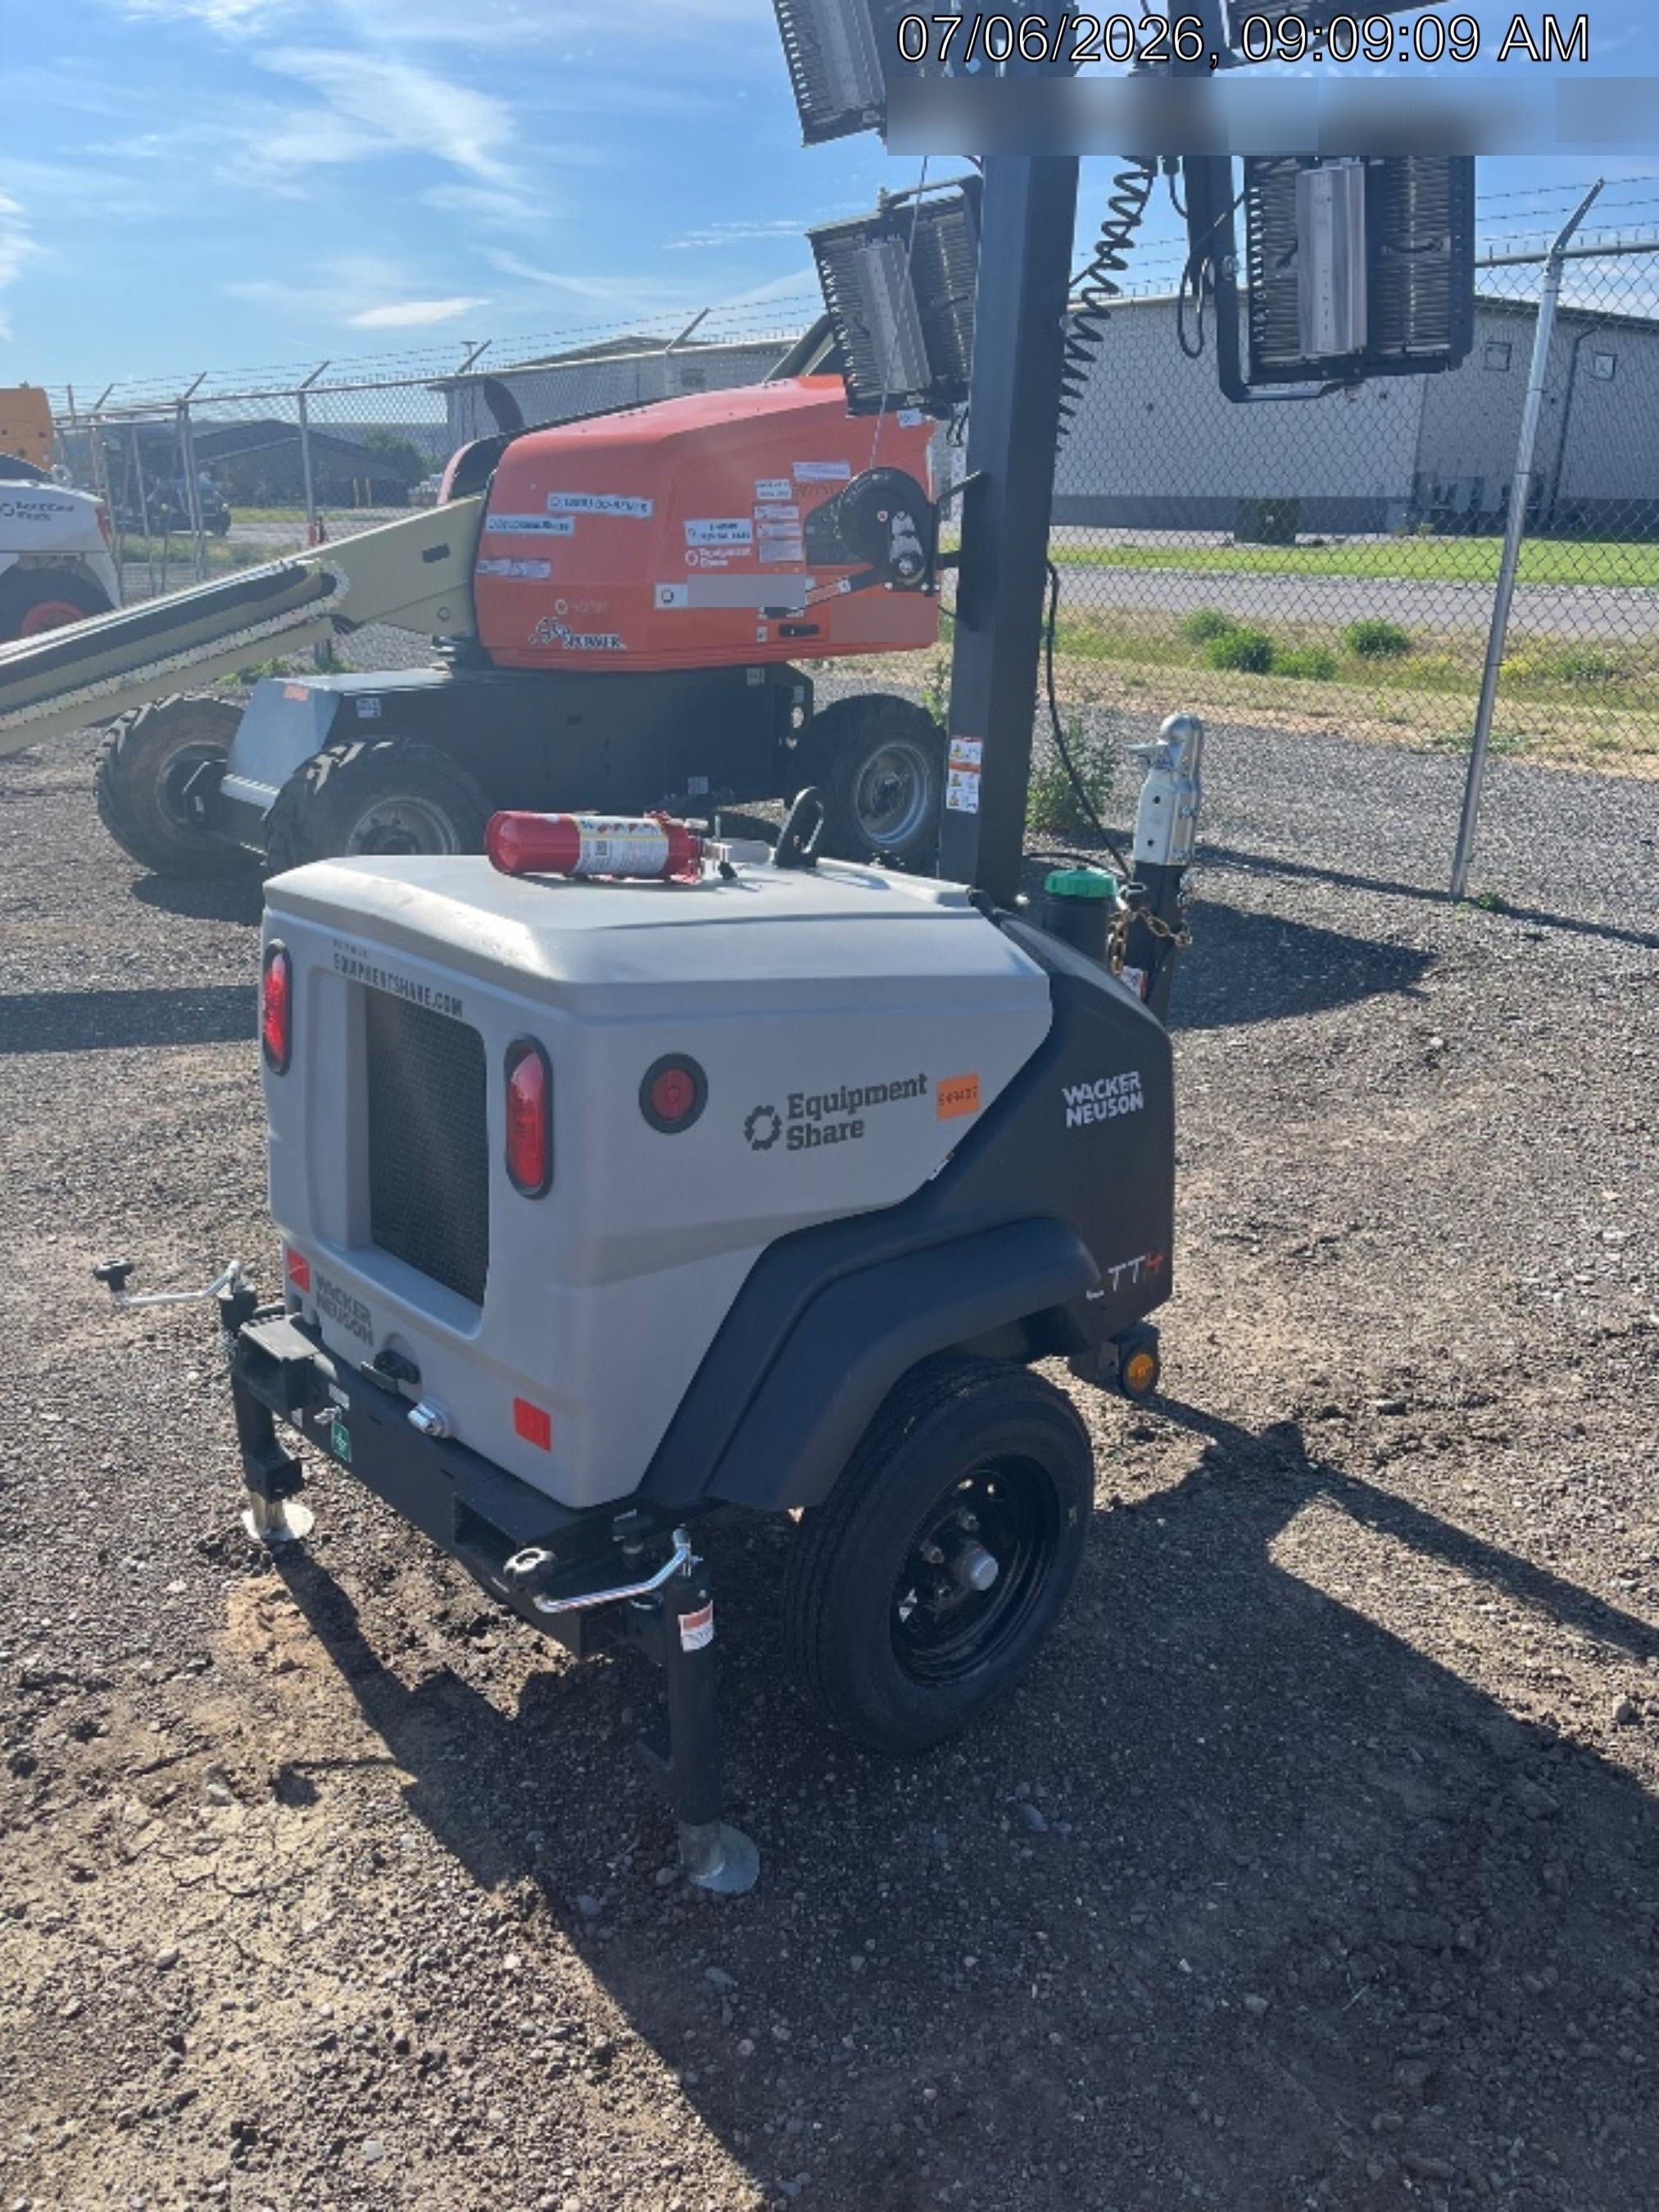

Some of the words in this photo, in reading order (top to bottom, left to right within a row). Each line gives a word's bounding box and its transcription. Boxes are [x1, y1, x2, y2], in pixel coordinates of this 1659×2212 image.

[786, 1072, 928, 1122] Equipment
[1061, 1070, 1141, 1107] WACKER
[1065, 1090, 1145, 1129] NEUSON
[786, 1118, 864, 1151] Share
[315, 1270, 372, 1328] WACKER
[316, 1289, 374, 1348] NEUSON
